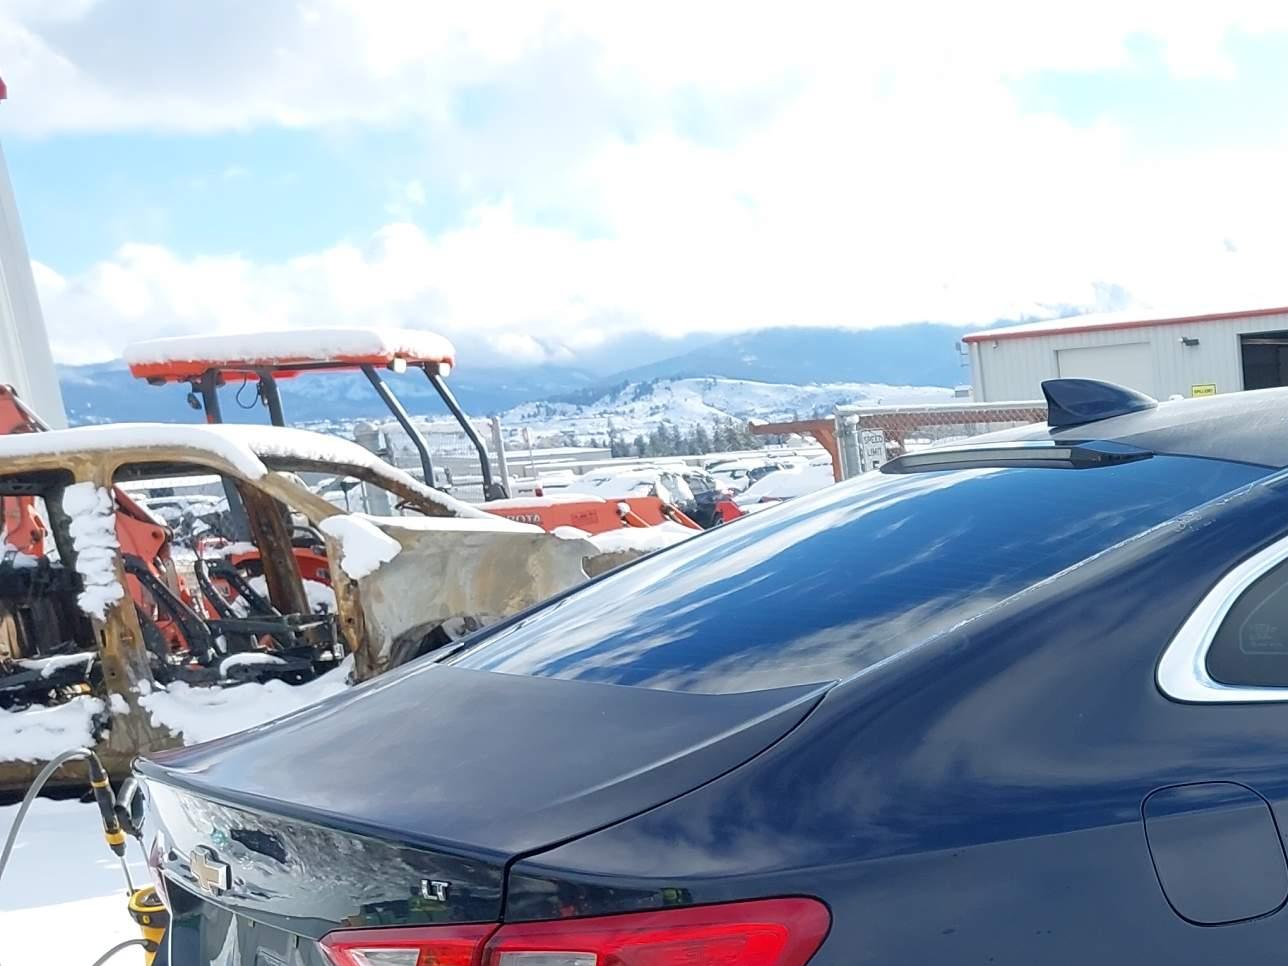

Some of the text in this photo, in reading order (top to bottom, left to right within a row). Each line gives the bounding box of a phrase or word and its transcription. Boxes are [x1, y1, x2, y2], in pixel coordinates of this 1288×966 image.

[863, 434, 882, 444] SPEED
[867, 447, 882, 457] LIMIT
[421, 879, 450, 902] LT
